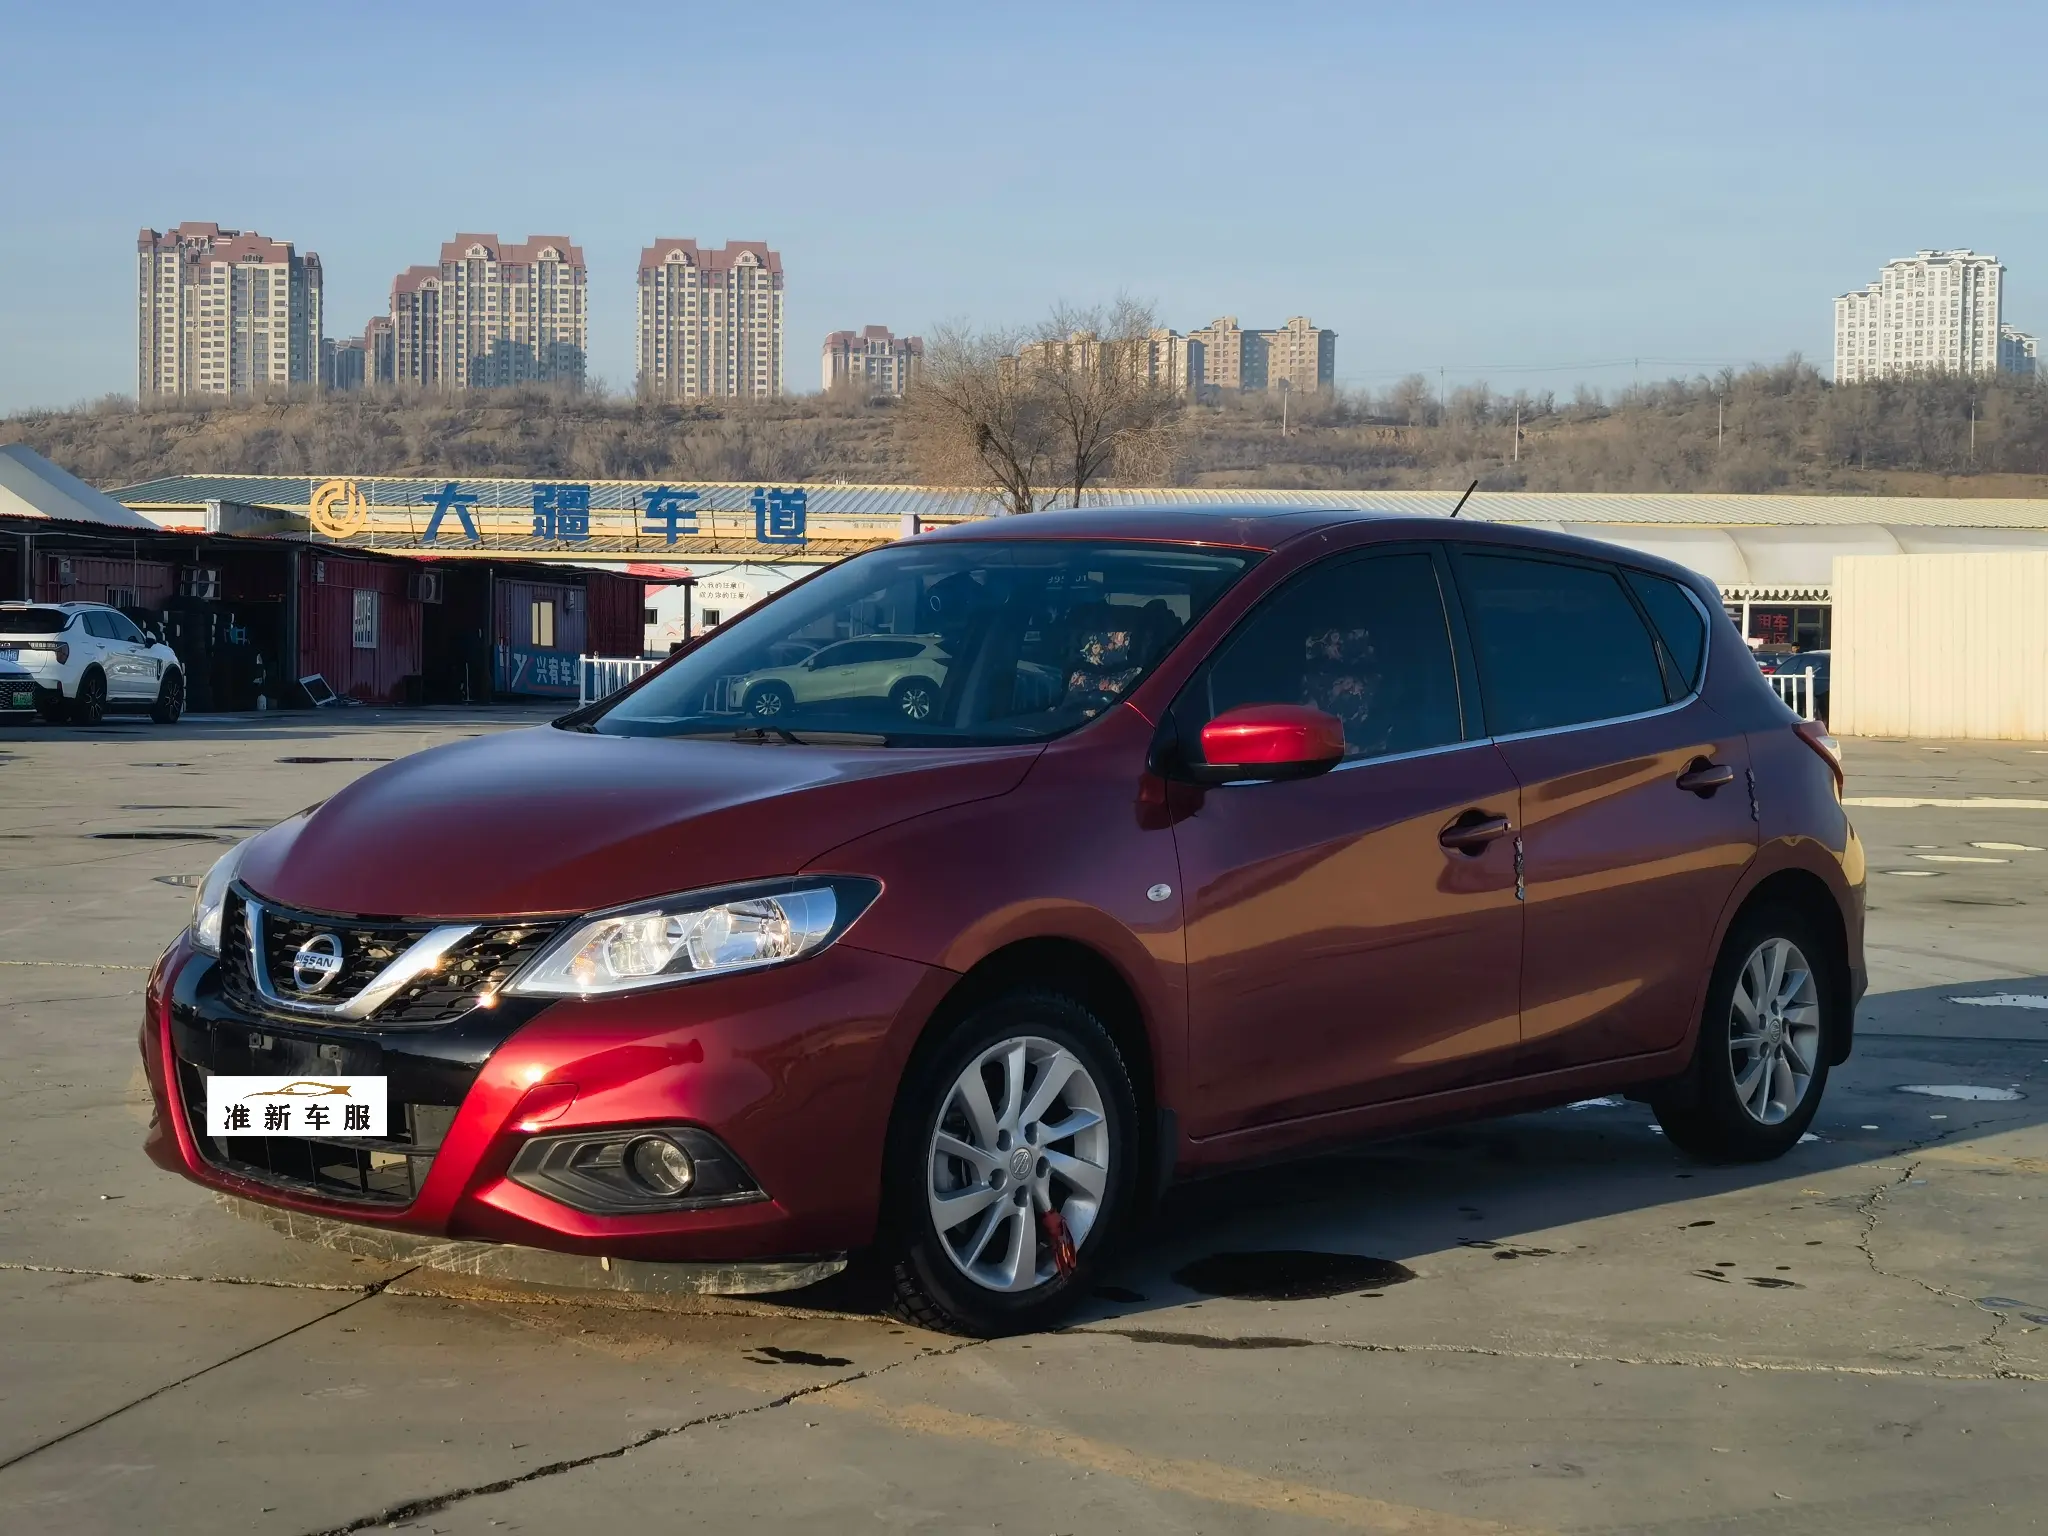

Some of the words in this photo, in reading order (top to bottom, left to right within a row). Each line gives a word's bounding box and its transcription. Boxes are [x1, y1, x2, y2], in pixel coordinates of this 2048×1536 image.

[422, 482, 808, 545] 大疆车道
[296, 954, 334, 968] NISSAN
